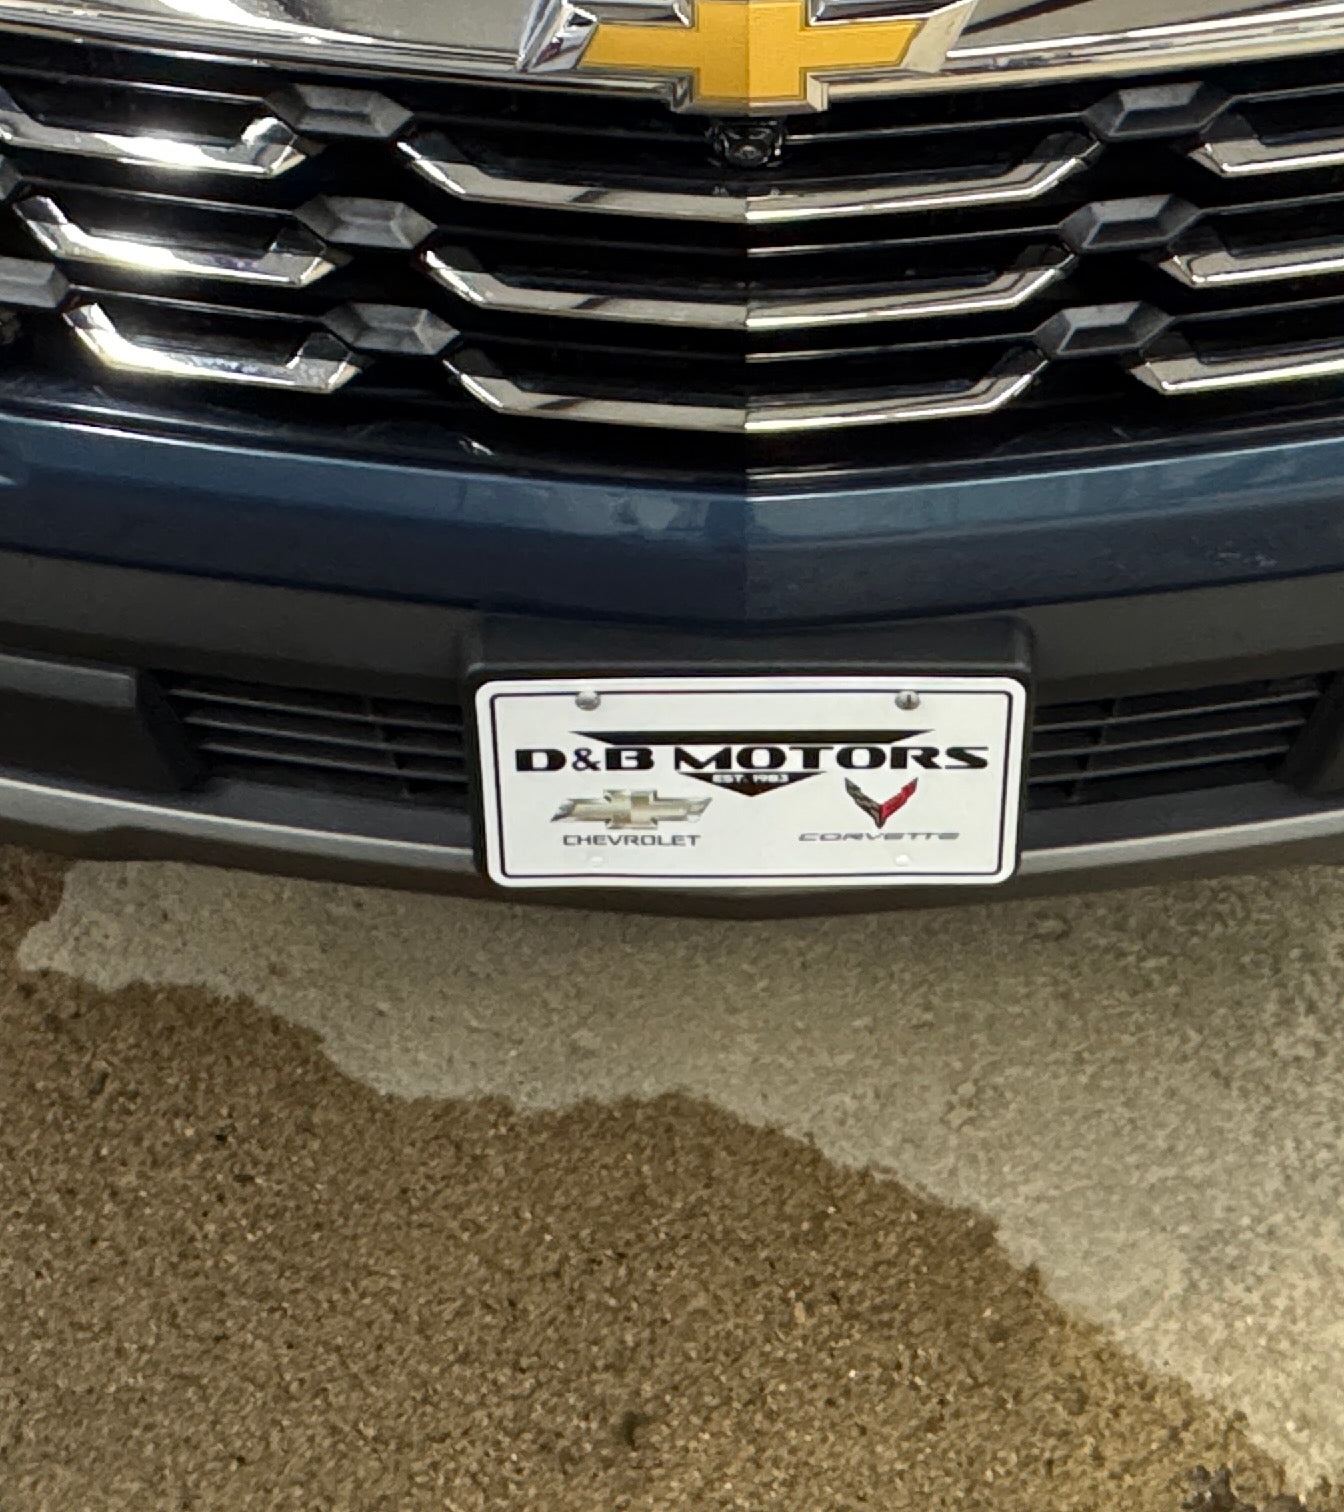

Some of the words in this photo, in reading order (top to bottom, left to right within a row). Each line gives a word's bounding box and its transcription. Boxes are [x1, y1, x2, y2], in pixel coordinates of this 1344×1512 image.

[515, 747, 655, 772] D&B
[674, 746, 989, 770] MOTORS
[562, 834, 701, 846] CHEVROLET
[798, 832, 960, 842] CORVETTE
